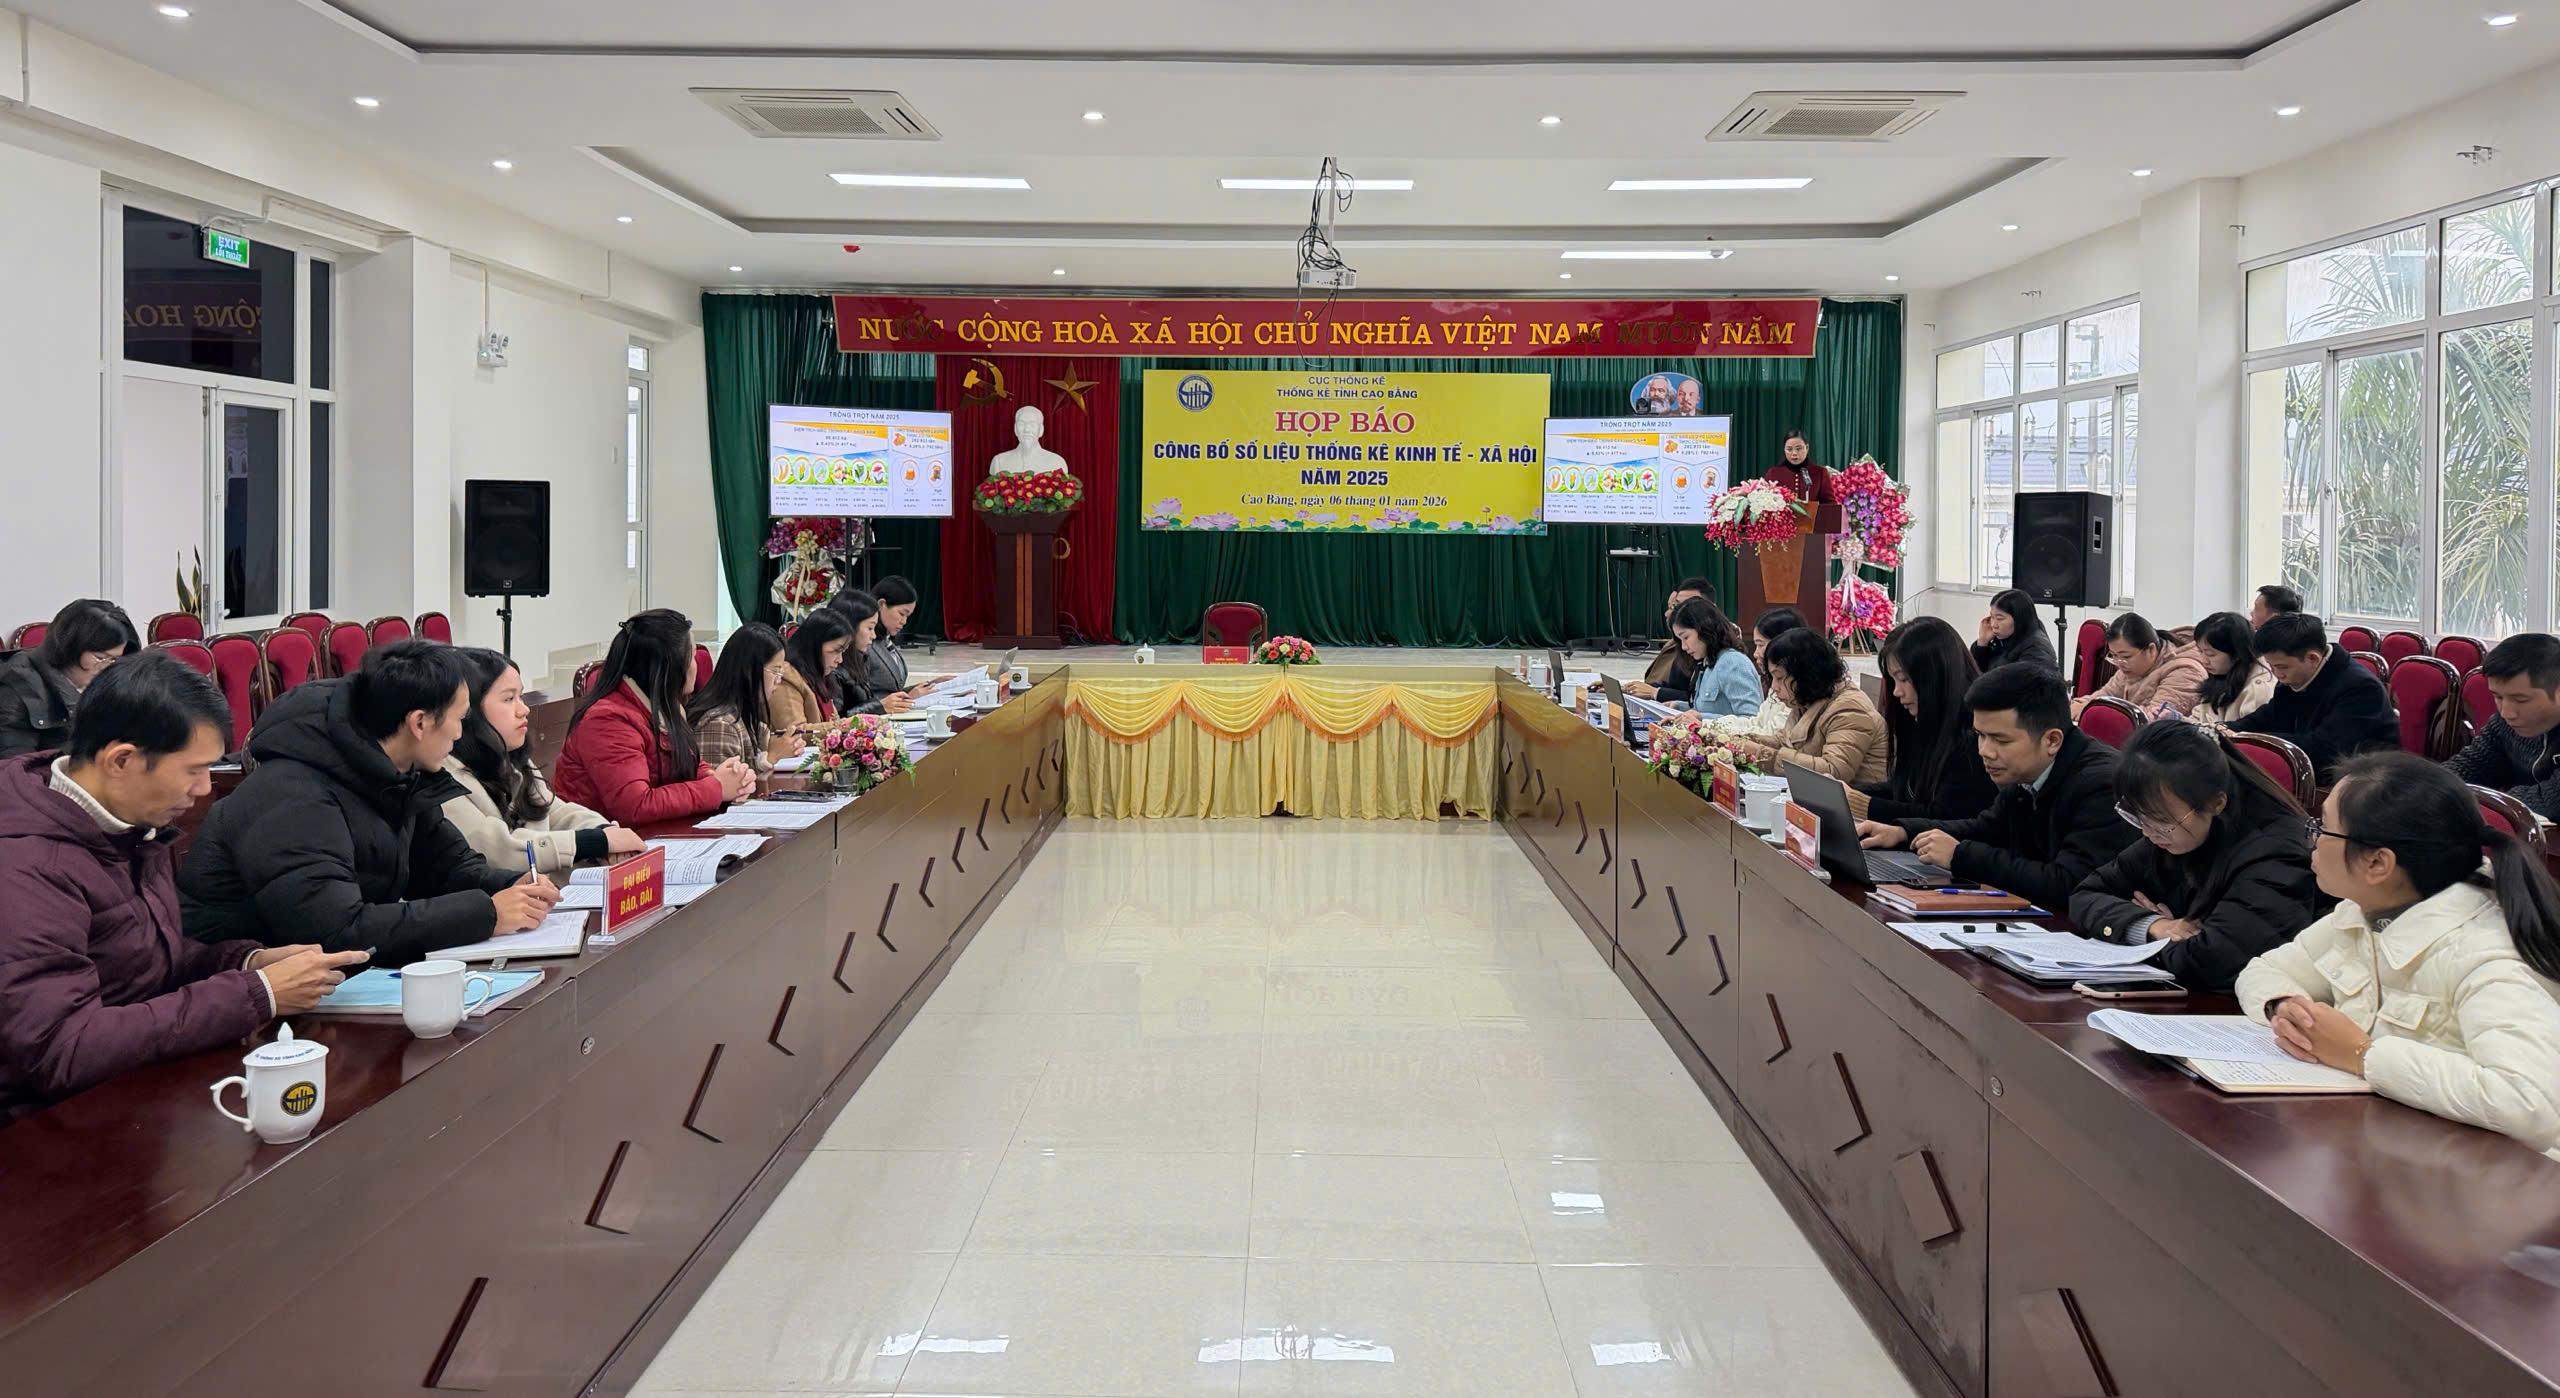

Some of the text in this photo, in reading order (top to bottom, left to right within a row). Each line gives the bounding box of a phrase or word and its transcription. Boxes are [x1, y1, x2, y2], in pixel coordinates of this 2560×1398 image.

[218, 236, 240, 250] EXIT
[957, 311, 1043, 349] CỘNG
[1052, 313, 1119, 344] HOÀ
[1129, 316, 1176, 345] XÃ
[1187, 314, 1243, 351] HỘI
[1254, 310, 1319, 345] CHỦ
[1329, 315, 1433, 345] NGHĨA
[1440, 314, 1517, 351] VIỆT
[1528, 322, 1604, 345] NAM
[1719, 315, 1796, 345] NĂM
[1371, 375, 1386, 386] KÊ
[1277, 385, 1314, 397] THỐNG
[1317, 387, 1330, 398] KÊ
[1334, 386, 1358, 398] TỈNH
[1361, 389, 1384, 398] CAO
[1274, 406, 1416, 438] HỌP BÁO
[1153, 441, 1200, 459] CÔNG
[1206, 438, 1230, 460] BỐ
[1234, 439, 1259, 460] SỐ
[1263, 441, 1300, 463] LIỆU
[1305, 440, 1362, 461] THỐNG
[1367, 443, 1389, 461] KÊ
[1395, 446, 1437, 462] KINH
[1442, 442, 1462, 463] TẾ
[1479, 444, 1503, 463] XÃ
[1508, 444, 1537, 467] HỘI
[1301, 467, 1388, 486] NĂM 2025
[1241, 494, 1263, 505] Cao
[1300, 494, 1326, 508] ngày
[1329, 495, 1342, 505] 06
[1345, 495, 1376, 507] tháng
[1379, 495, 1391, 506] 01
[1422, 496, 1448, 507] 2026
[623, 873, 635, 891] ĐẠI
[620, 886, 653, 916] BÁO, ĐÀI
